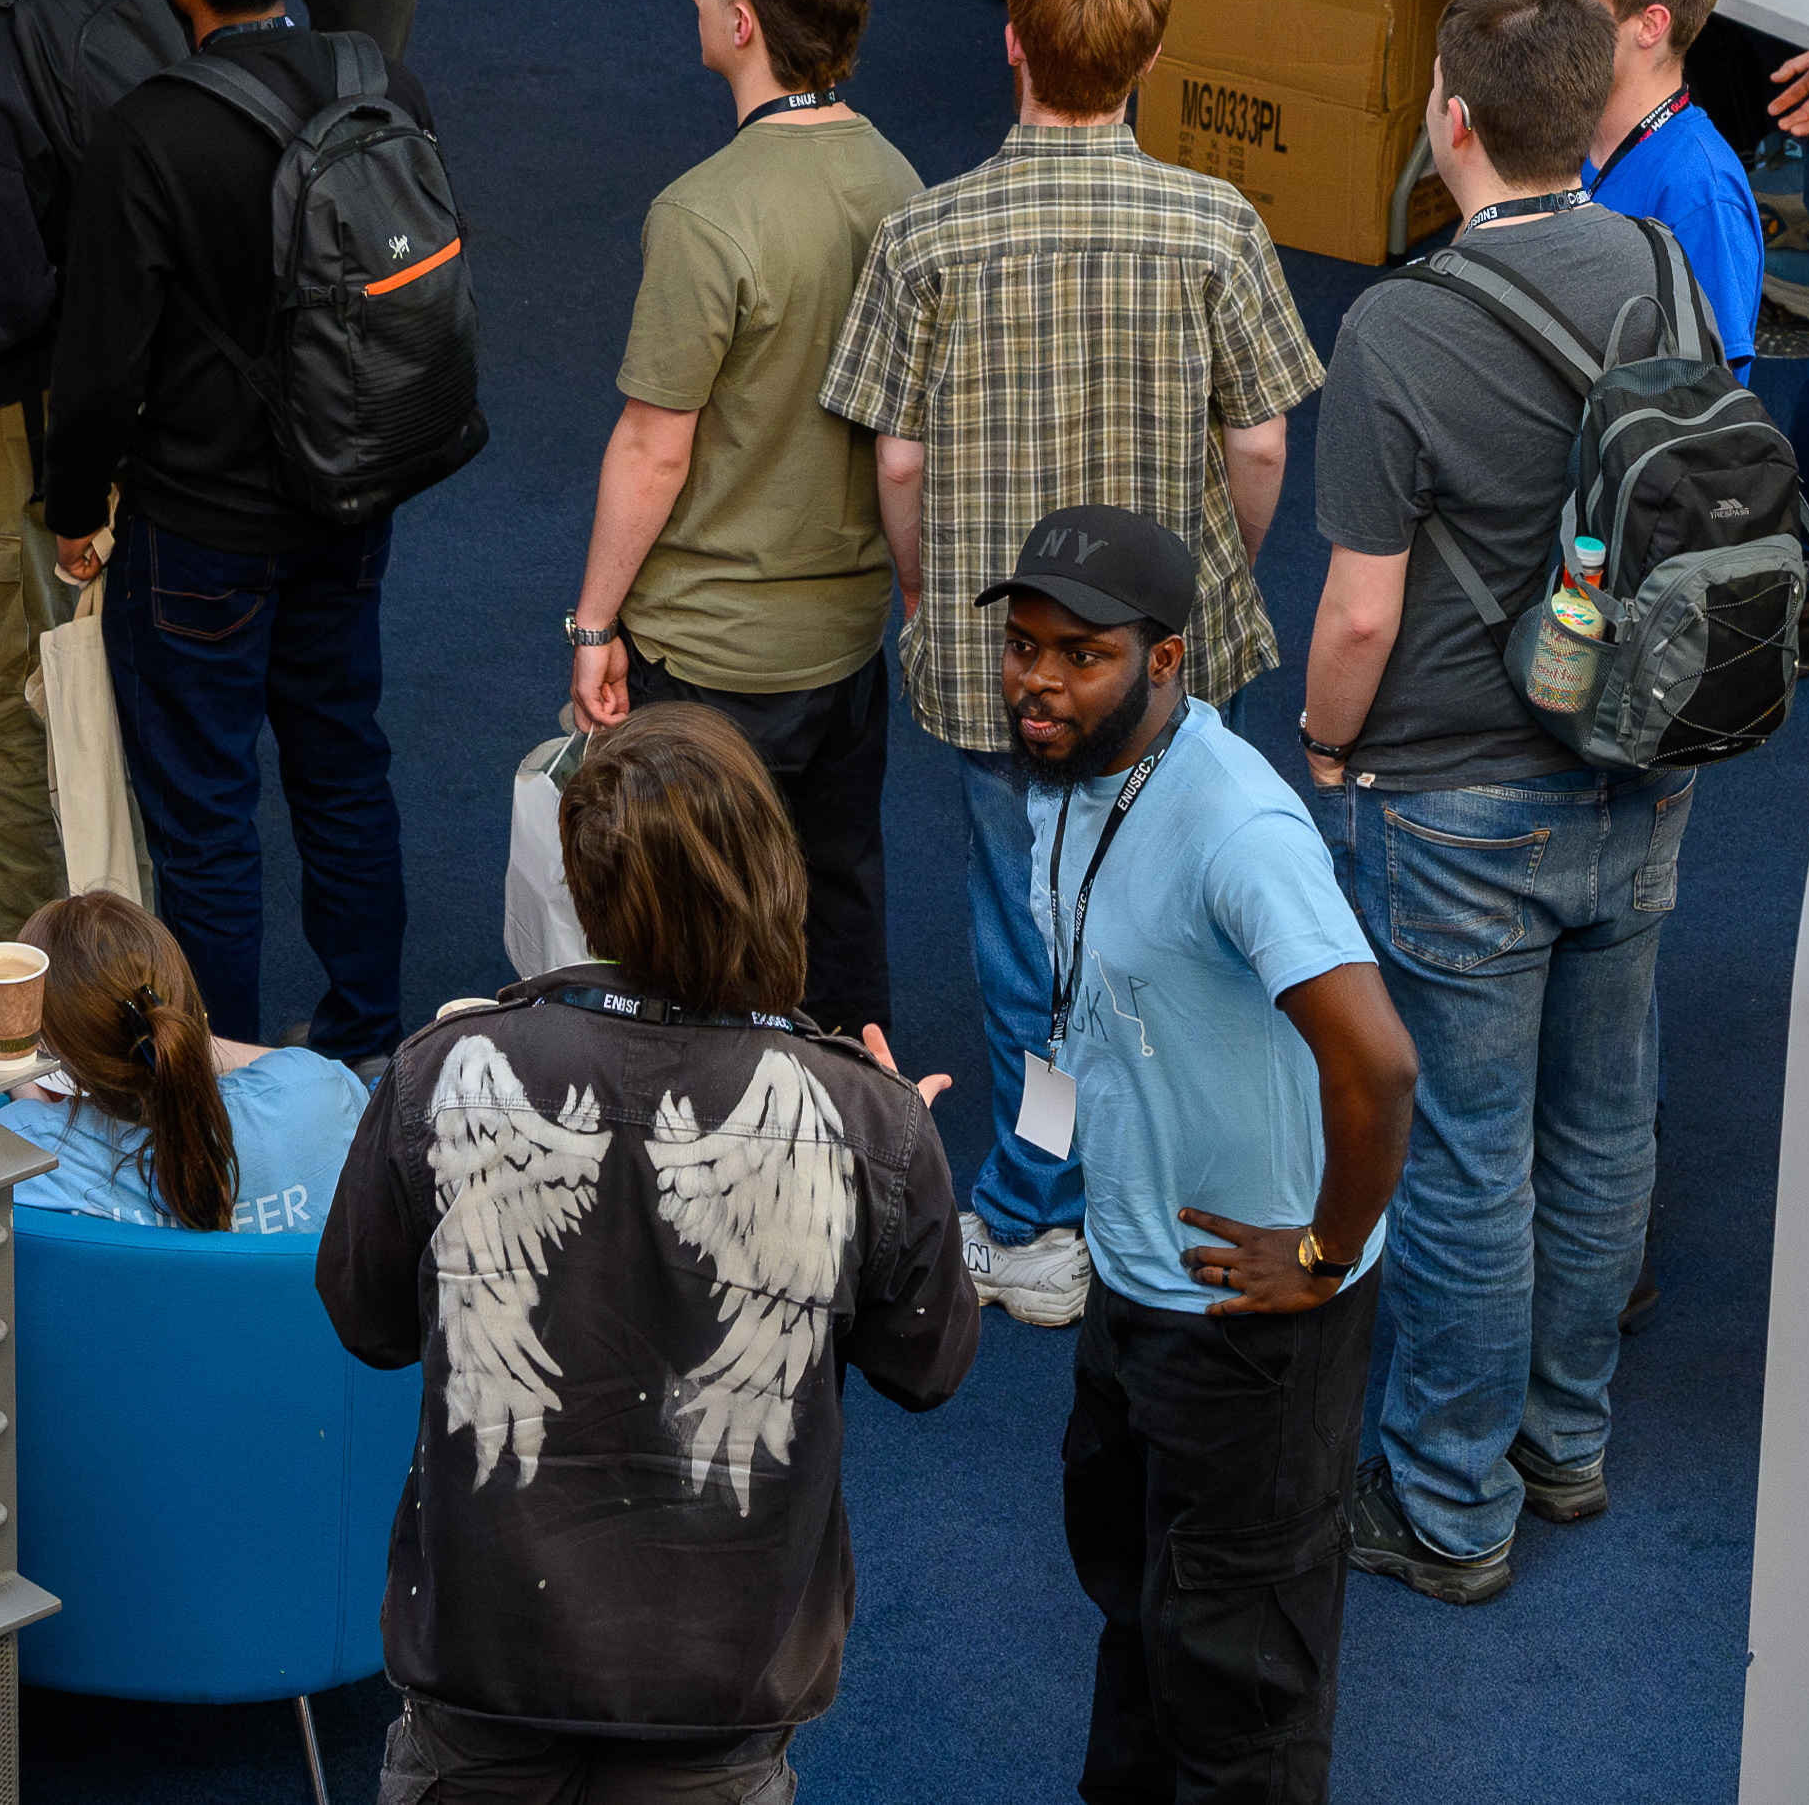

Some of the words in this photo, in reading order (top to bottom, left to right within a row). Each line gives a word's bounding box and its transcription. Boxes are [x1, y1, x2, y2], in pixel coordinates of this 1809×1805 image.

[1181, 79, 1289, 154] MG0333PL
[1709, 507, 1750, 520] TRESPASS
[1035, 527, 1110, 566] NY
